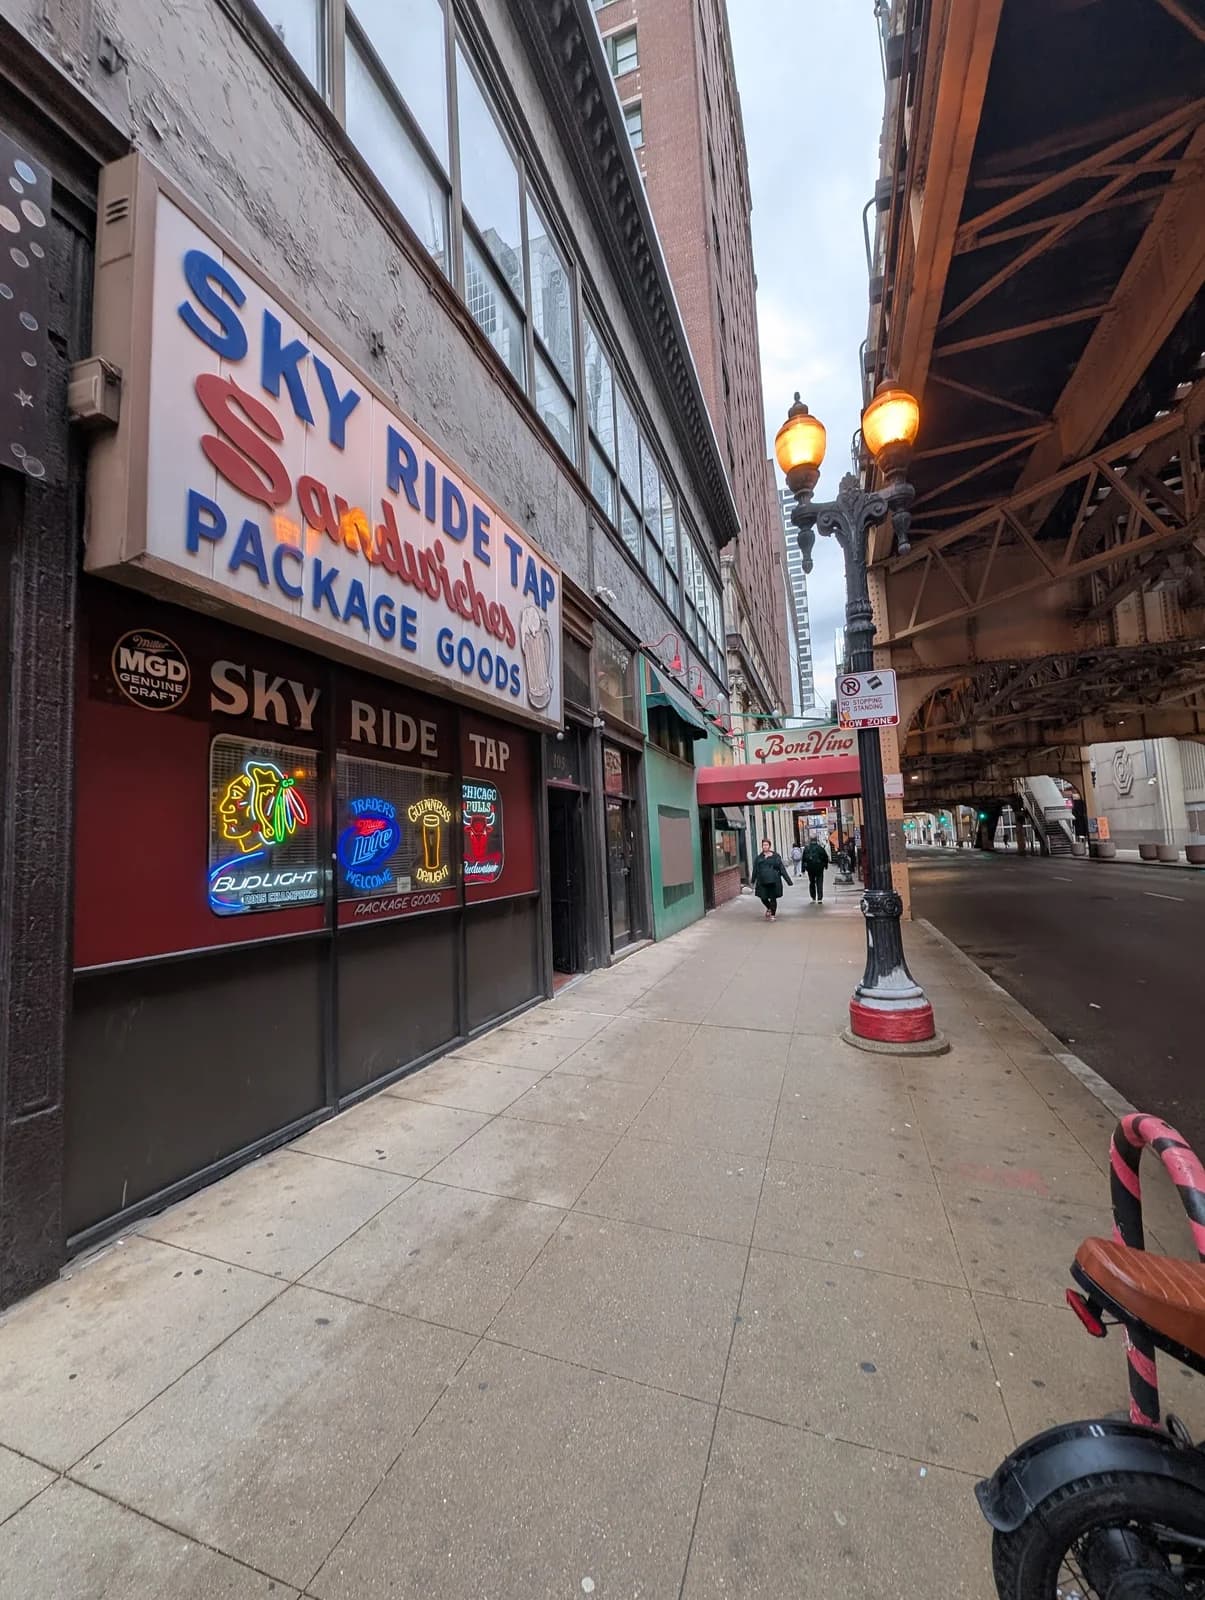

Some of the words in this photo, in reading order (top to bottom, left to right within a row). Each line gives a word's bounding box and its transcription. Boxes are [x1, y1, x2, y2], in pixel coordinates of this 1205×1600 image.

[178, 249, 361, 450] SKY
[387, 424, 491, 566] RIDE
[503, 533, 556, 612] TAP
[195, 373, 517, 648] Sandwiches
[186, 488, 418, 651] PACKAGE
[437, 628, 521, 696] GOODS
[119, 647, 187, 682] MGD
[120, 673, 184, 694] GENUINE
[129, 686, 178, 703] DRAFT
[852, 697, 882, 706] STOPPING
[210, 660, 321, 731] SKY
[351, 699, 439, 758] RIDE
[468, 733, 510, 772] TAP
[853, 703, 884, 711] STANDING
[843, 719, 863, 728] TOW
[867, 717, 894, 726] ZONE
[462, 784, 496, 801] CHICAGO
[407, 798, 452, 823] GUINNESS
[466, 801, 491, 813] BULLS
[346, 867, 393, 889] WELCOME
[416, 864, 449, 884] DRAUGHT
[354, 896, 408, 916] PACKAGE
[411, 893, 442, 908] GOODS
